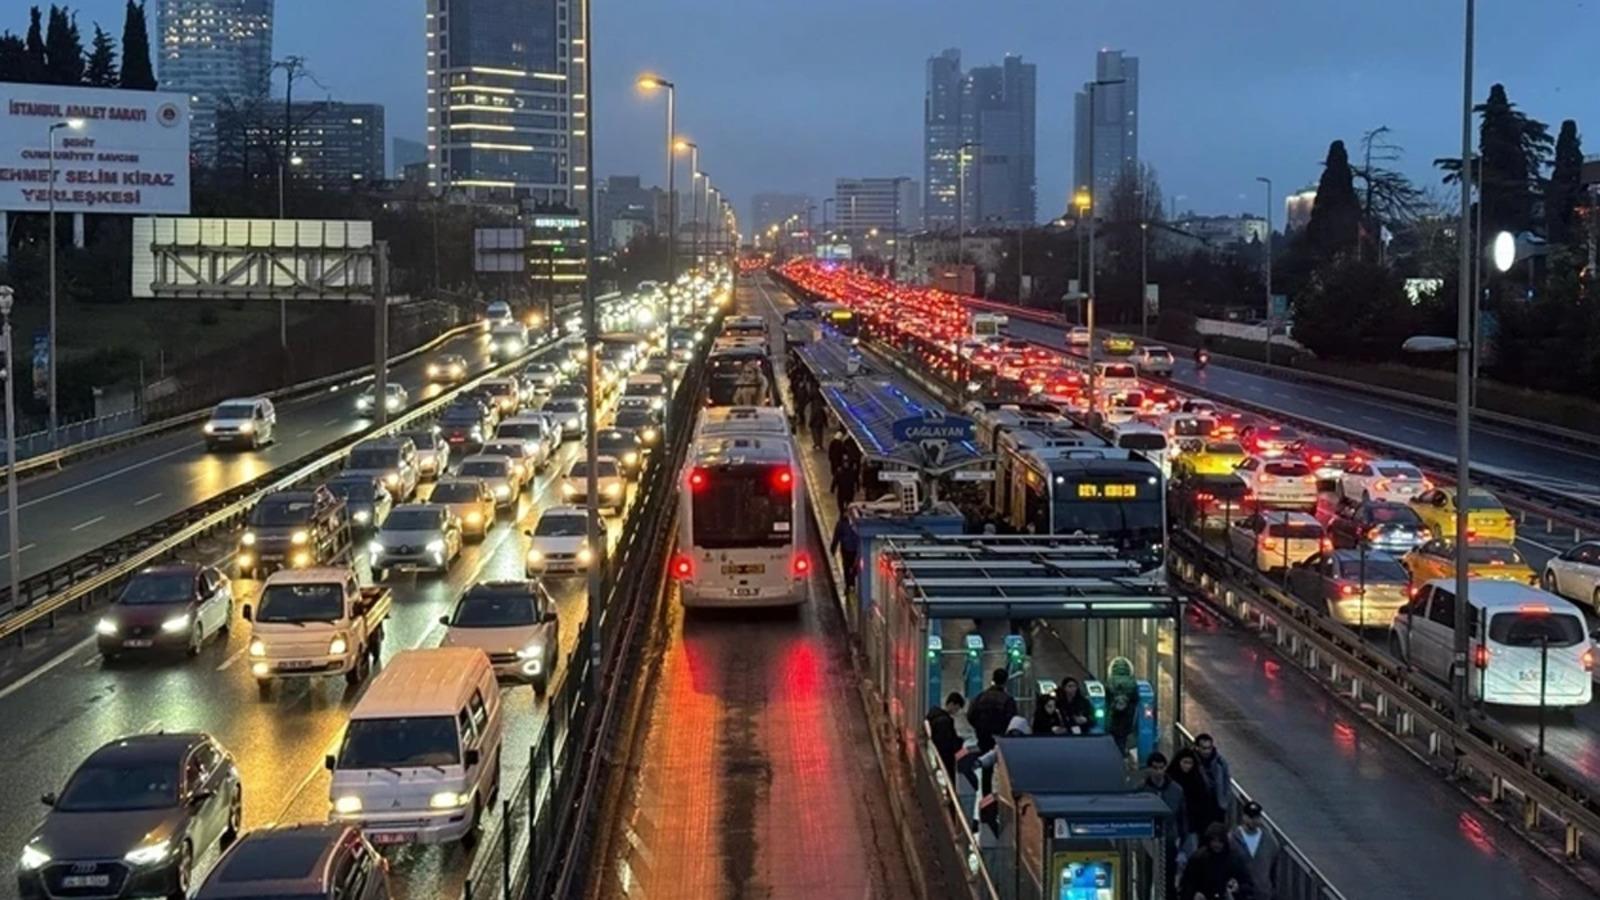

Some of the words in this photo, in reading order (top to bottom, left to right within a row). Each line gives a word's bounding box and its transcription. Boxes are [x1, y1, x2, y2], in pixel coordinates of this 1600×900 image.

[9, 99, 63, 117] İSTANBUL
[65, 168, 118, 185] SELİM
[123, 170, 175, 186] KİRAZ
[905, 425, 964, 439] ÇAĞLAYAN
